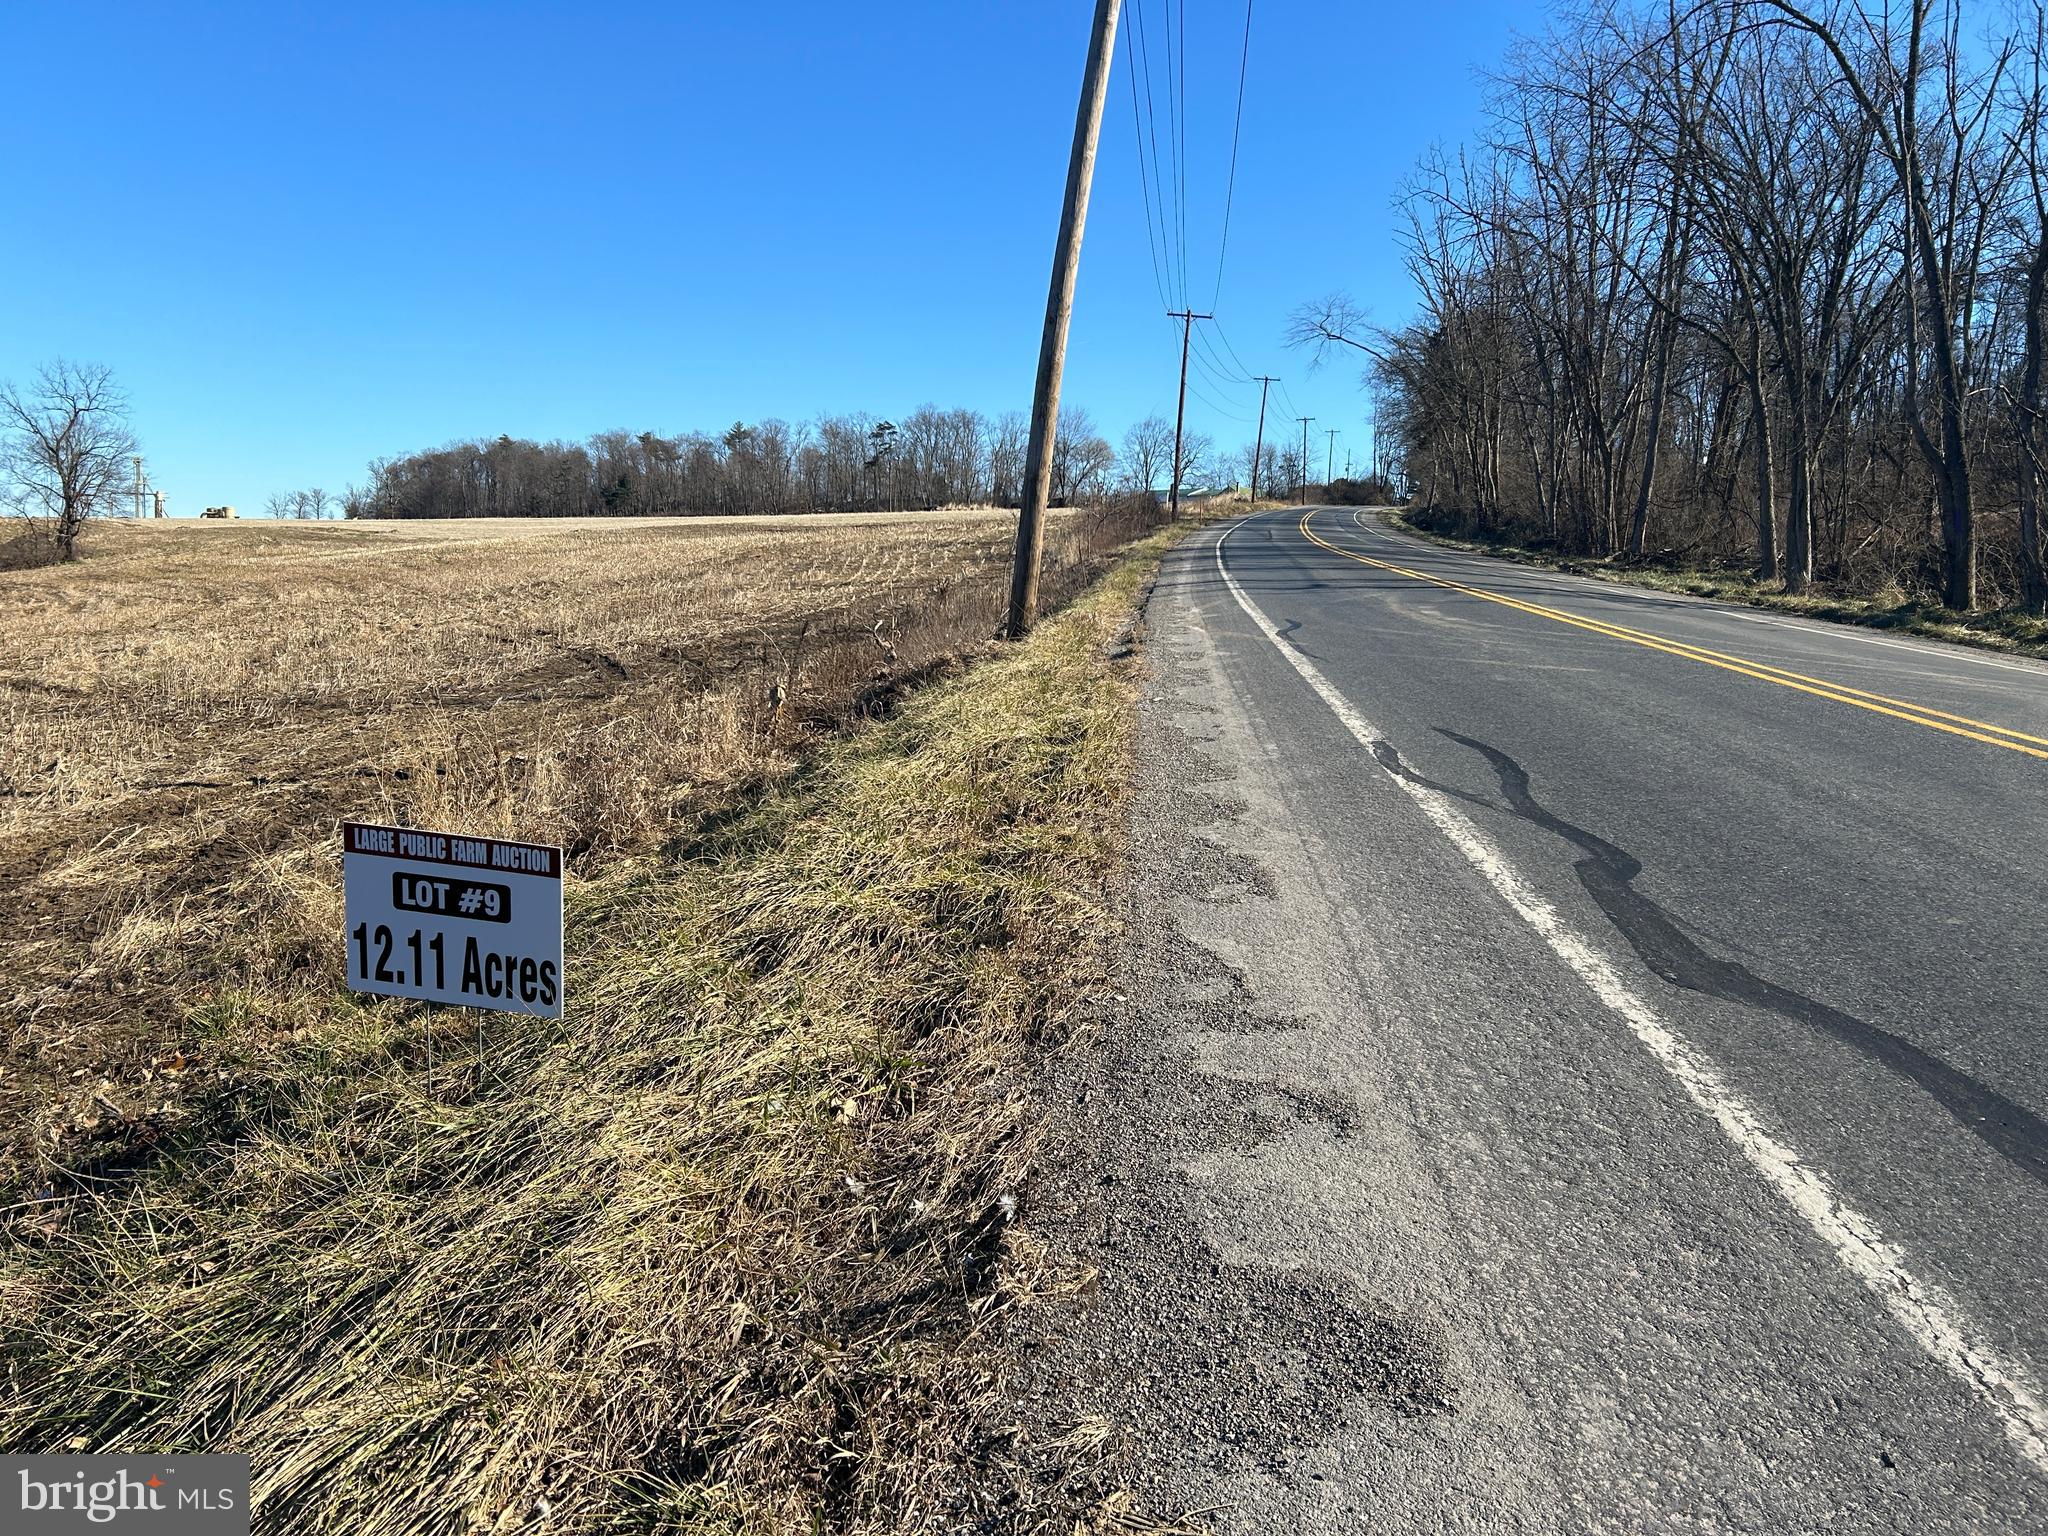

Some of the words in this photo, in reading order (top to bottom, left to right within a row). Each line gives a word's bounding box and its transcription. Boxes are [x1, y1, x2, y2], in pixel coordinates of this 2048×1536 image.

[353, 827, 395, 854] LARGE
[399, 832, 447, 860] PUBLIC
[451, 839, 487, 865] FARM
[491, 844, 550, 873] AUCTION
[401, 878, 450, 910] LOT
[458, 887, 500, 916] #9
[353, 922, 444, 990] 12.11
[461, 936, 557, 1006] Acres
